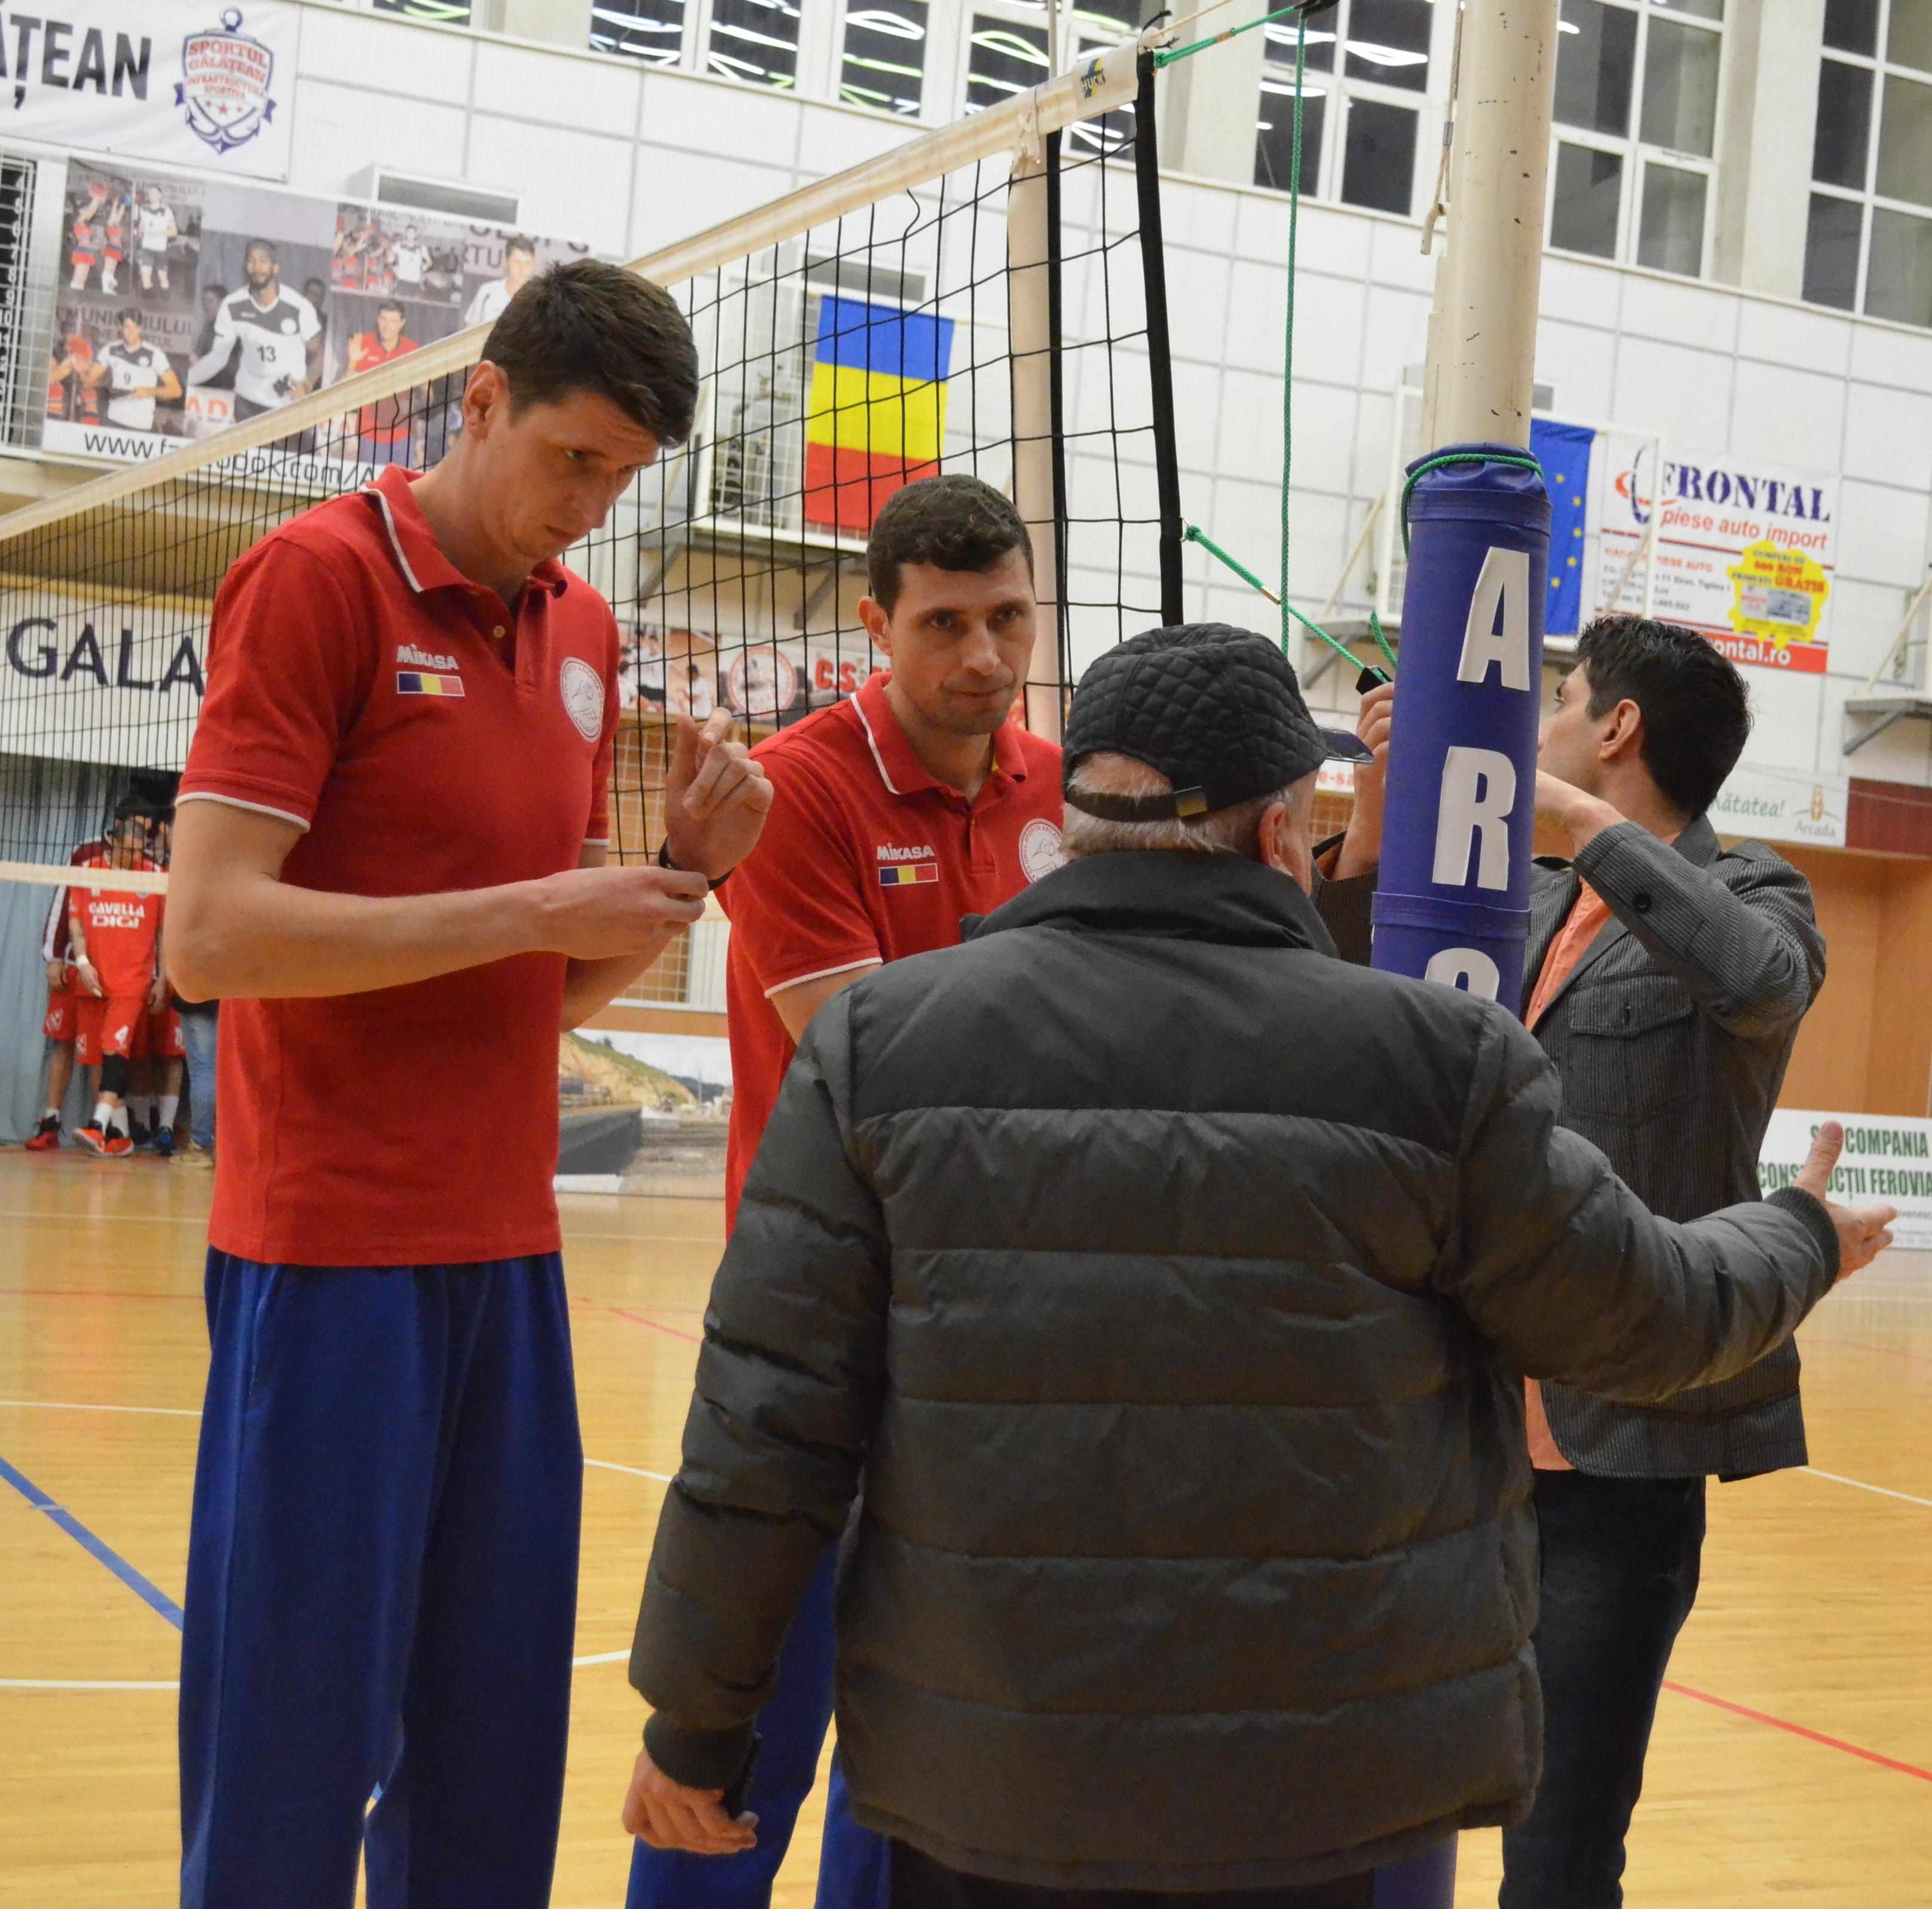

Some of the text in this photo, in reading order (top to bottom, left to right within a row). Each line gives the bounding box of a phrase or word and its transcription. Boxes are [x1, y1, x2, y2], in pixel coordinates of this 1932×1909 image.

[188, 41, 267, 69] SPORTUL
[257, 345, 276, 363] 13
[1662, 460, 1830, 522] FRONTAL
[1660, 507, 1827, 550] piese auto import
[1845, 1127, 1928, 1158] COMPANIA
